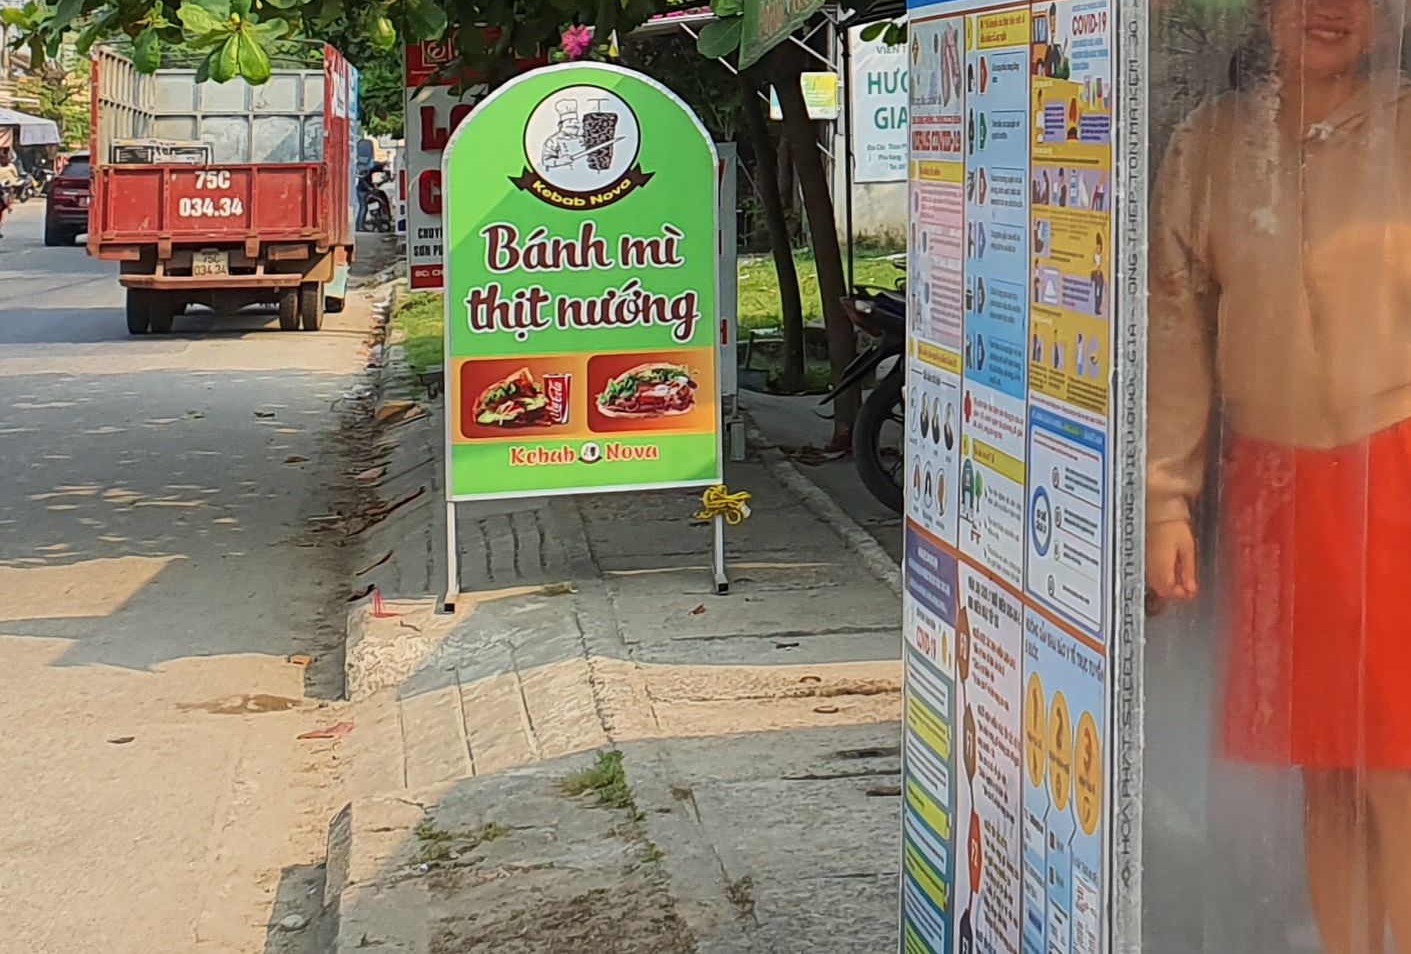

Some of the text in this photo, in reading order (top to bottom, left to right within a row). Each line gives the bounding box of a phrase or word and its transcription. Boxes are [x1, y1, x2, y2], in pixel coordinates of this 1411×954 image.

[1071, 11, 1108, 35] COVID-19
[195, 170, 231, 190] 75C
[532, 178, 632, 207] Kebab Nova
[179, 197, 243, 217] 034.34
[482, 223, 682, 271] Bánh mì
[466, 280, 699, 340] thịt nướng
[511, 444, 659, 465] Kebab Nova
[1056, 706, 1063, 750] 2
[1083, 727, 1092, 776] 3
